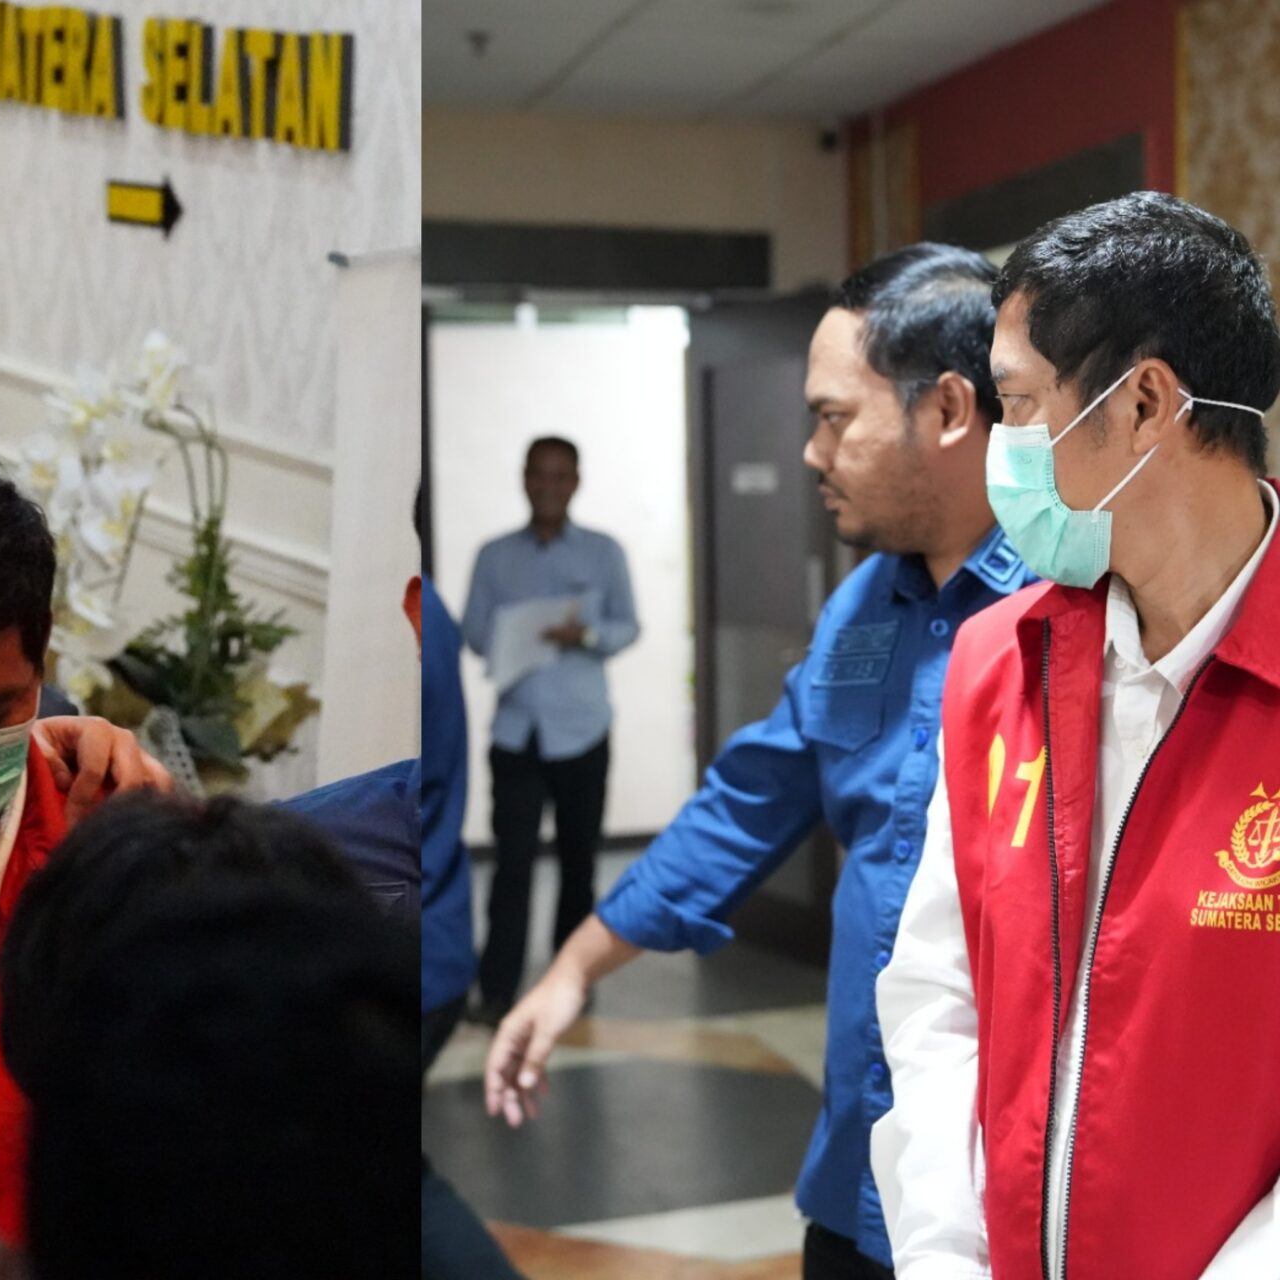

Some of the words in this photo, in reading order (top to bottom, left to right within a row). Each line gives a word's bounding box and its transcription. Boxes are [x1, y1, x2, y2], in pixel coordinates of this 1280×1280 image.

[139, 14, 354, 152] SELATAN
[1197, 889, 1274, 911] KEJAKSAAN
[1190, 907, 1262, 931] SUMATERA
